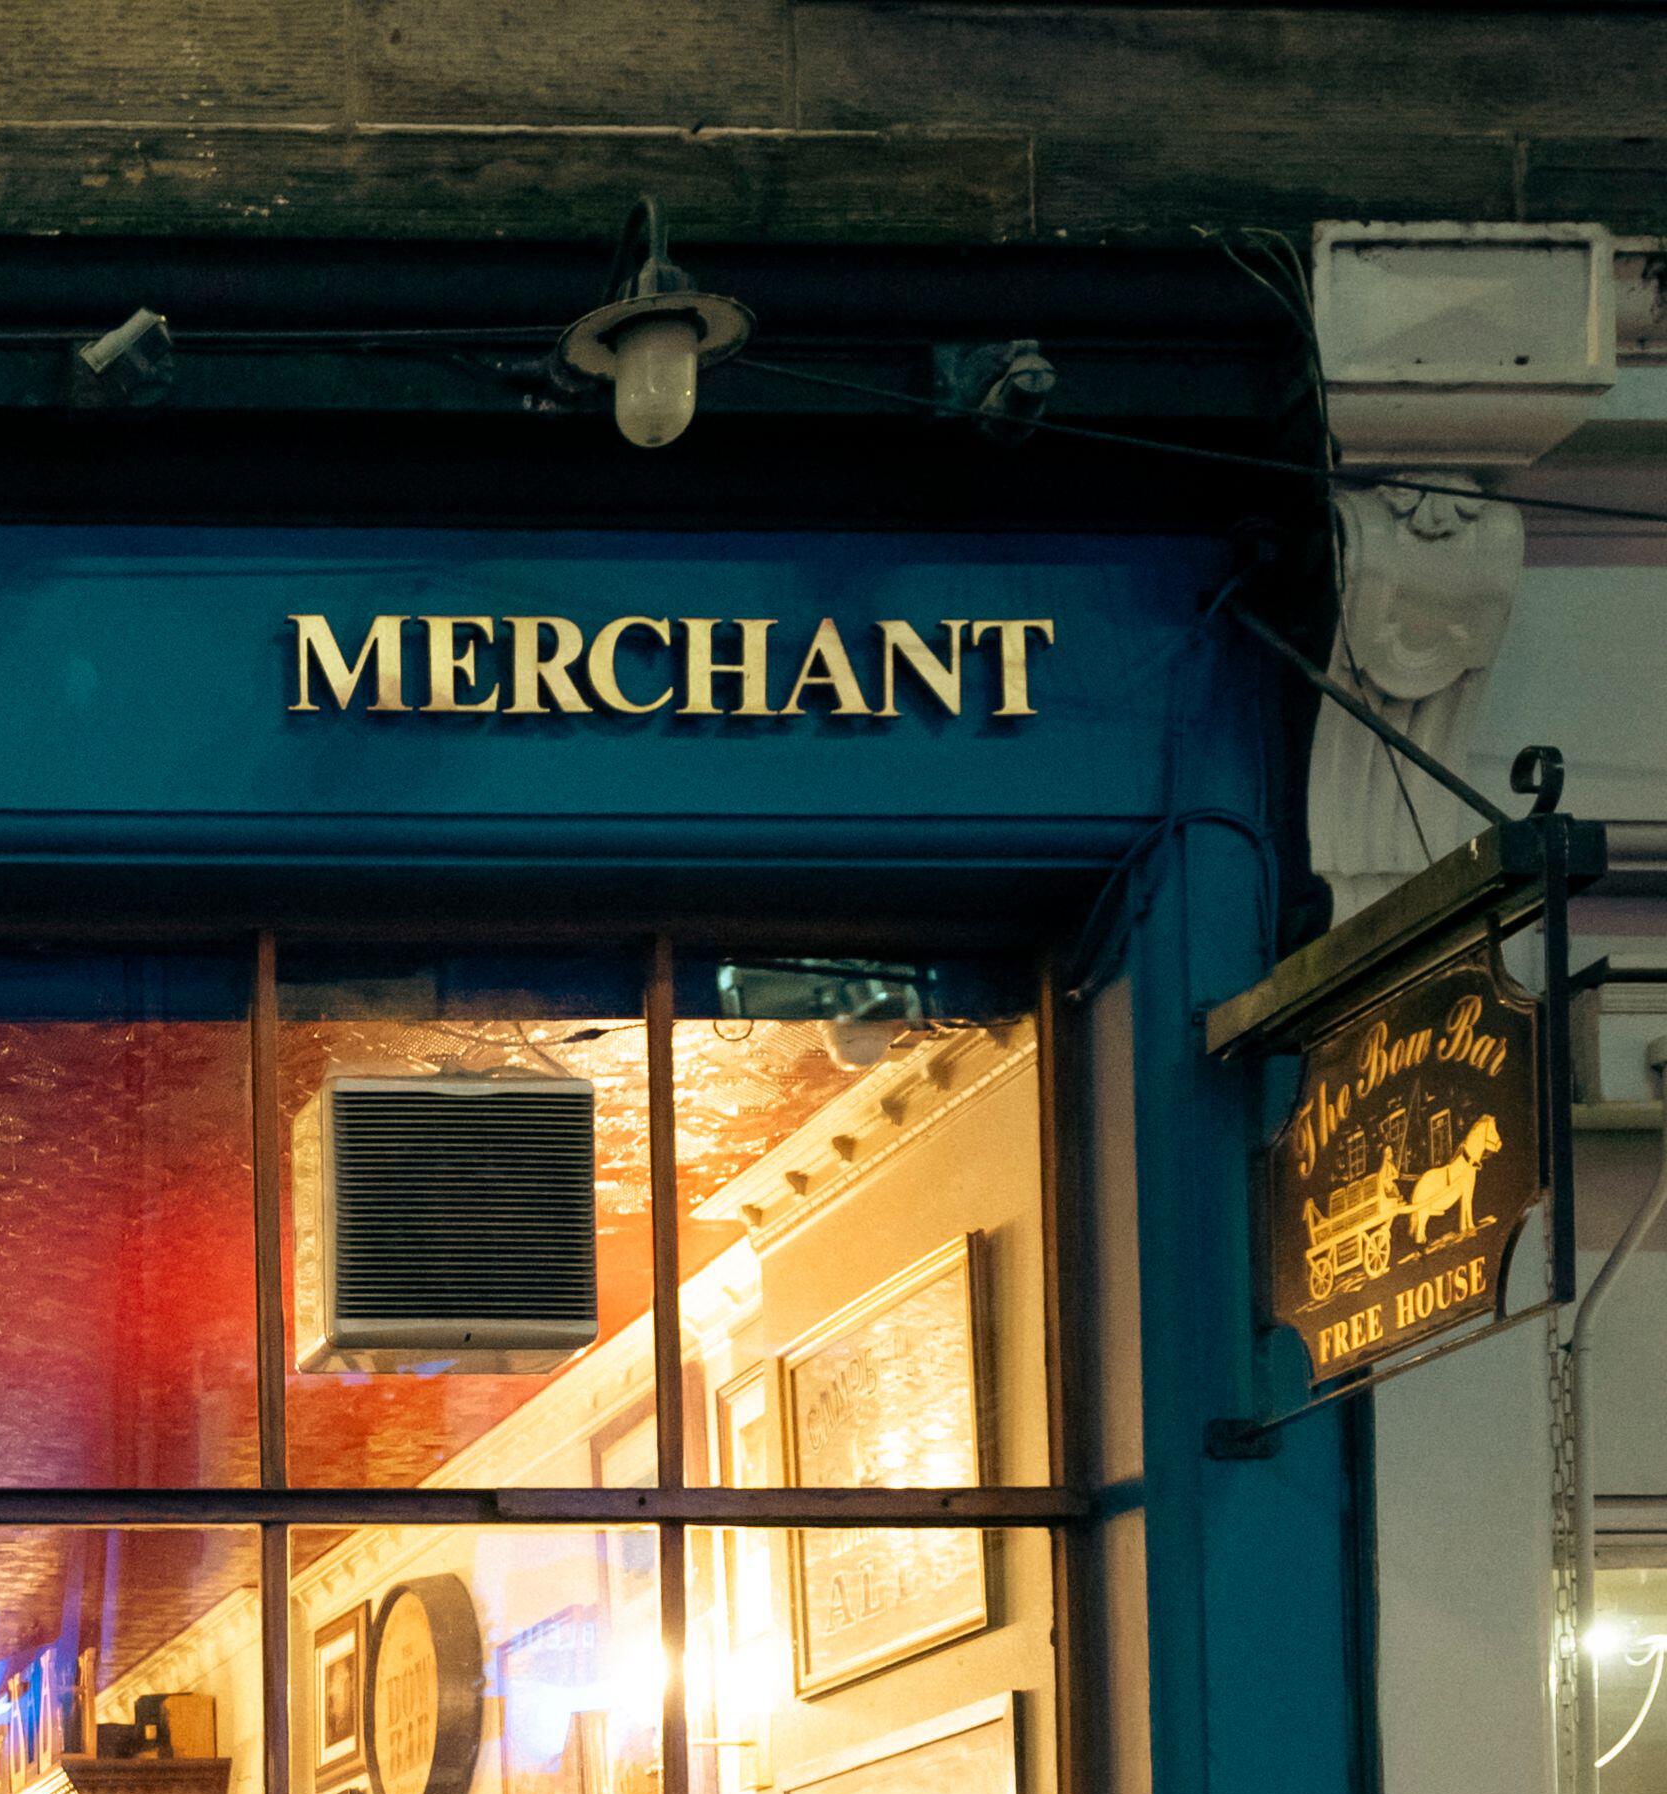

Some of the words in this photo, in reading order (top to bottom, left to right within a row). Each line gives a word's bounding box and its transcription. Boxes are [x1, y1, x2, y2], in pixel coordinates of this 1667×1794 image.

[286, 614, 1055, 718] MERCHANT
[1295, 1081, 1351, 1178] The
[1356, 1020, 1433, 1099] Bow
[1437, 994, 1508, 1078] Bar
[1318, 1303, 1383, 1365] FREE
[1396, 1256, 1487, 1331] HOUSE
